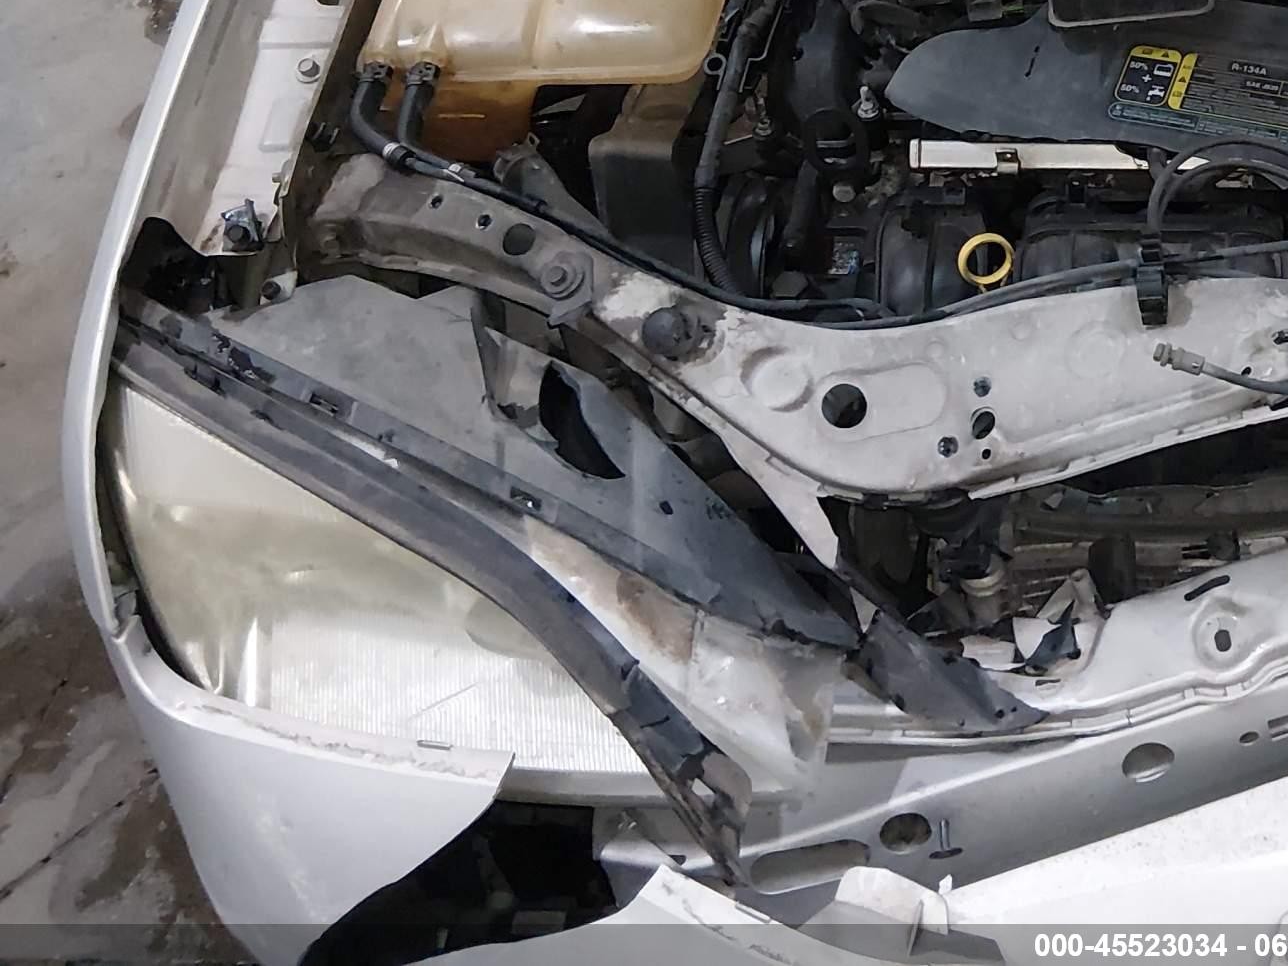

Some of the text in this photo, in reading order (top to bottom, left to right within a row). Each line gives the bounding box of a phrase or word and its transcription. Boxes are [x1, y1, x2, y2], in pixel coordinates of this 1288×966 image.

[1129, 61, 1148, 71] 50%
[1231, 62, 1267, 76] R-134A
[1120, 84, 1140, 94] 50%
